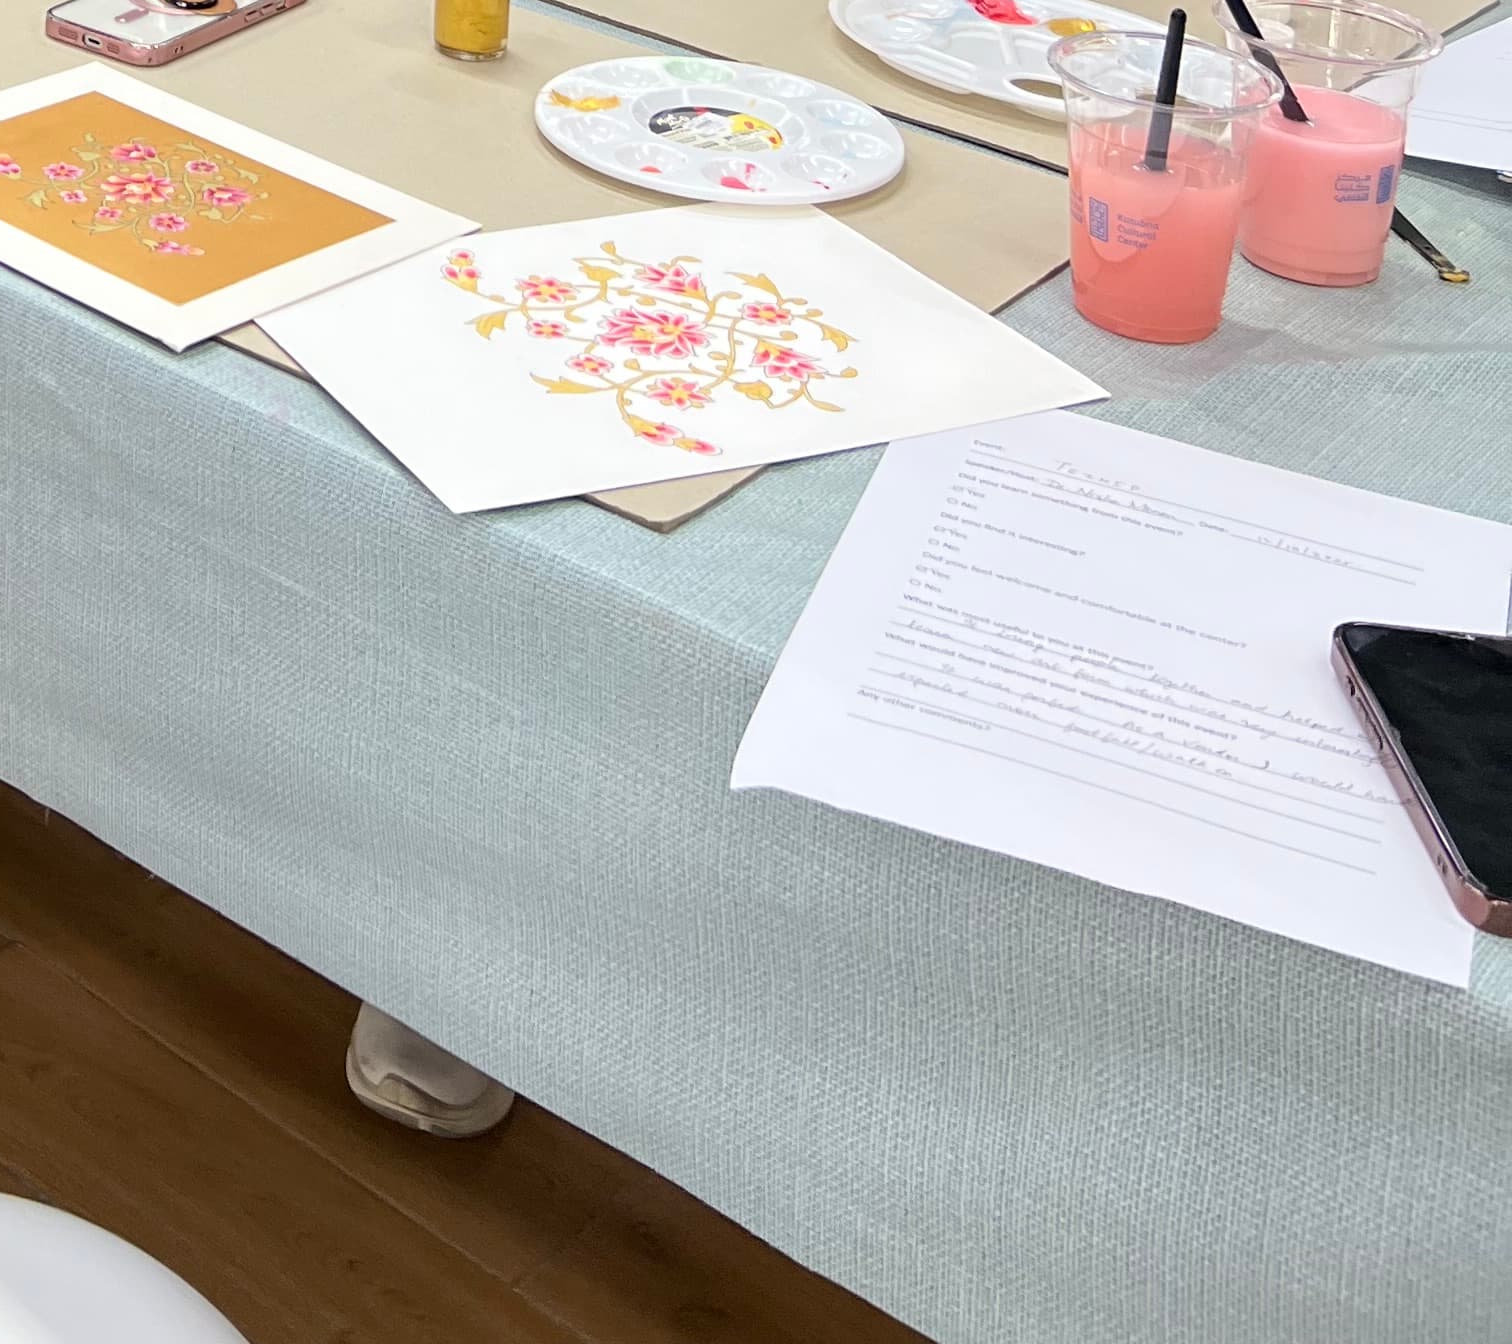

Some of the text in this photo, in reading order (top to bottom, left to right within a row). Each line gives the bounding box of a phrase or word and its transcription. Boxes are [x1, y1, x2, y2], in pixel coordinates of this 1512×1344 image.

[1117, 223, 1157, 242] Cultural
[1117, 234, 1148, 250] Center
[939, 511, 960, 521] Did
[983, 523, 1007, 535] find
[1017, 533, 1087, 557] interesting?
[1030, 491, 1089, 513] something
[1091, 507, 1119, 520] from
[1120, 516, 1142, 527] this
[1143, 522, 1184, 537] event?
[921, 551, 944, 563] Did
[944, 559, 969, 570] you
[970, 564, 993, 577] feel
[994, 573, 1052, 594] welcome
[1053, 591, 1080, 602] and
[1079, 598, 1157, 625] comfortable
[1175, 624, 1197, 636] the
[1198, 631, 1248, 649] center?
[903, 592, 934, 608] What
[960, 611, 991, 625] most
[992, 621, 1030, 636] useful
[1087, 647, 1110, 660] this
[1111, 655, 1155, 671] event?
[884, 631, 916, 647] What
[919, 642, 957, 657] would
[957, 652, 987, 667] have
[988, 662, 1048, 685] improved
[1049, 681, 1077, 694] your
[1079, 690, 1149, 716] experience
[1167, 715, 1191, 729] this
[1193, 724, 1238, 741] event?
[856, 688, 992, 731] Any other comments?
